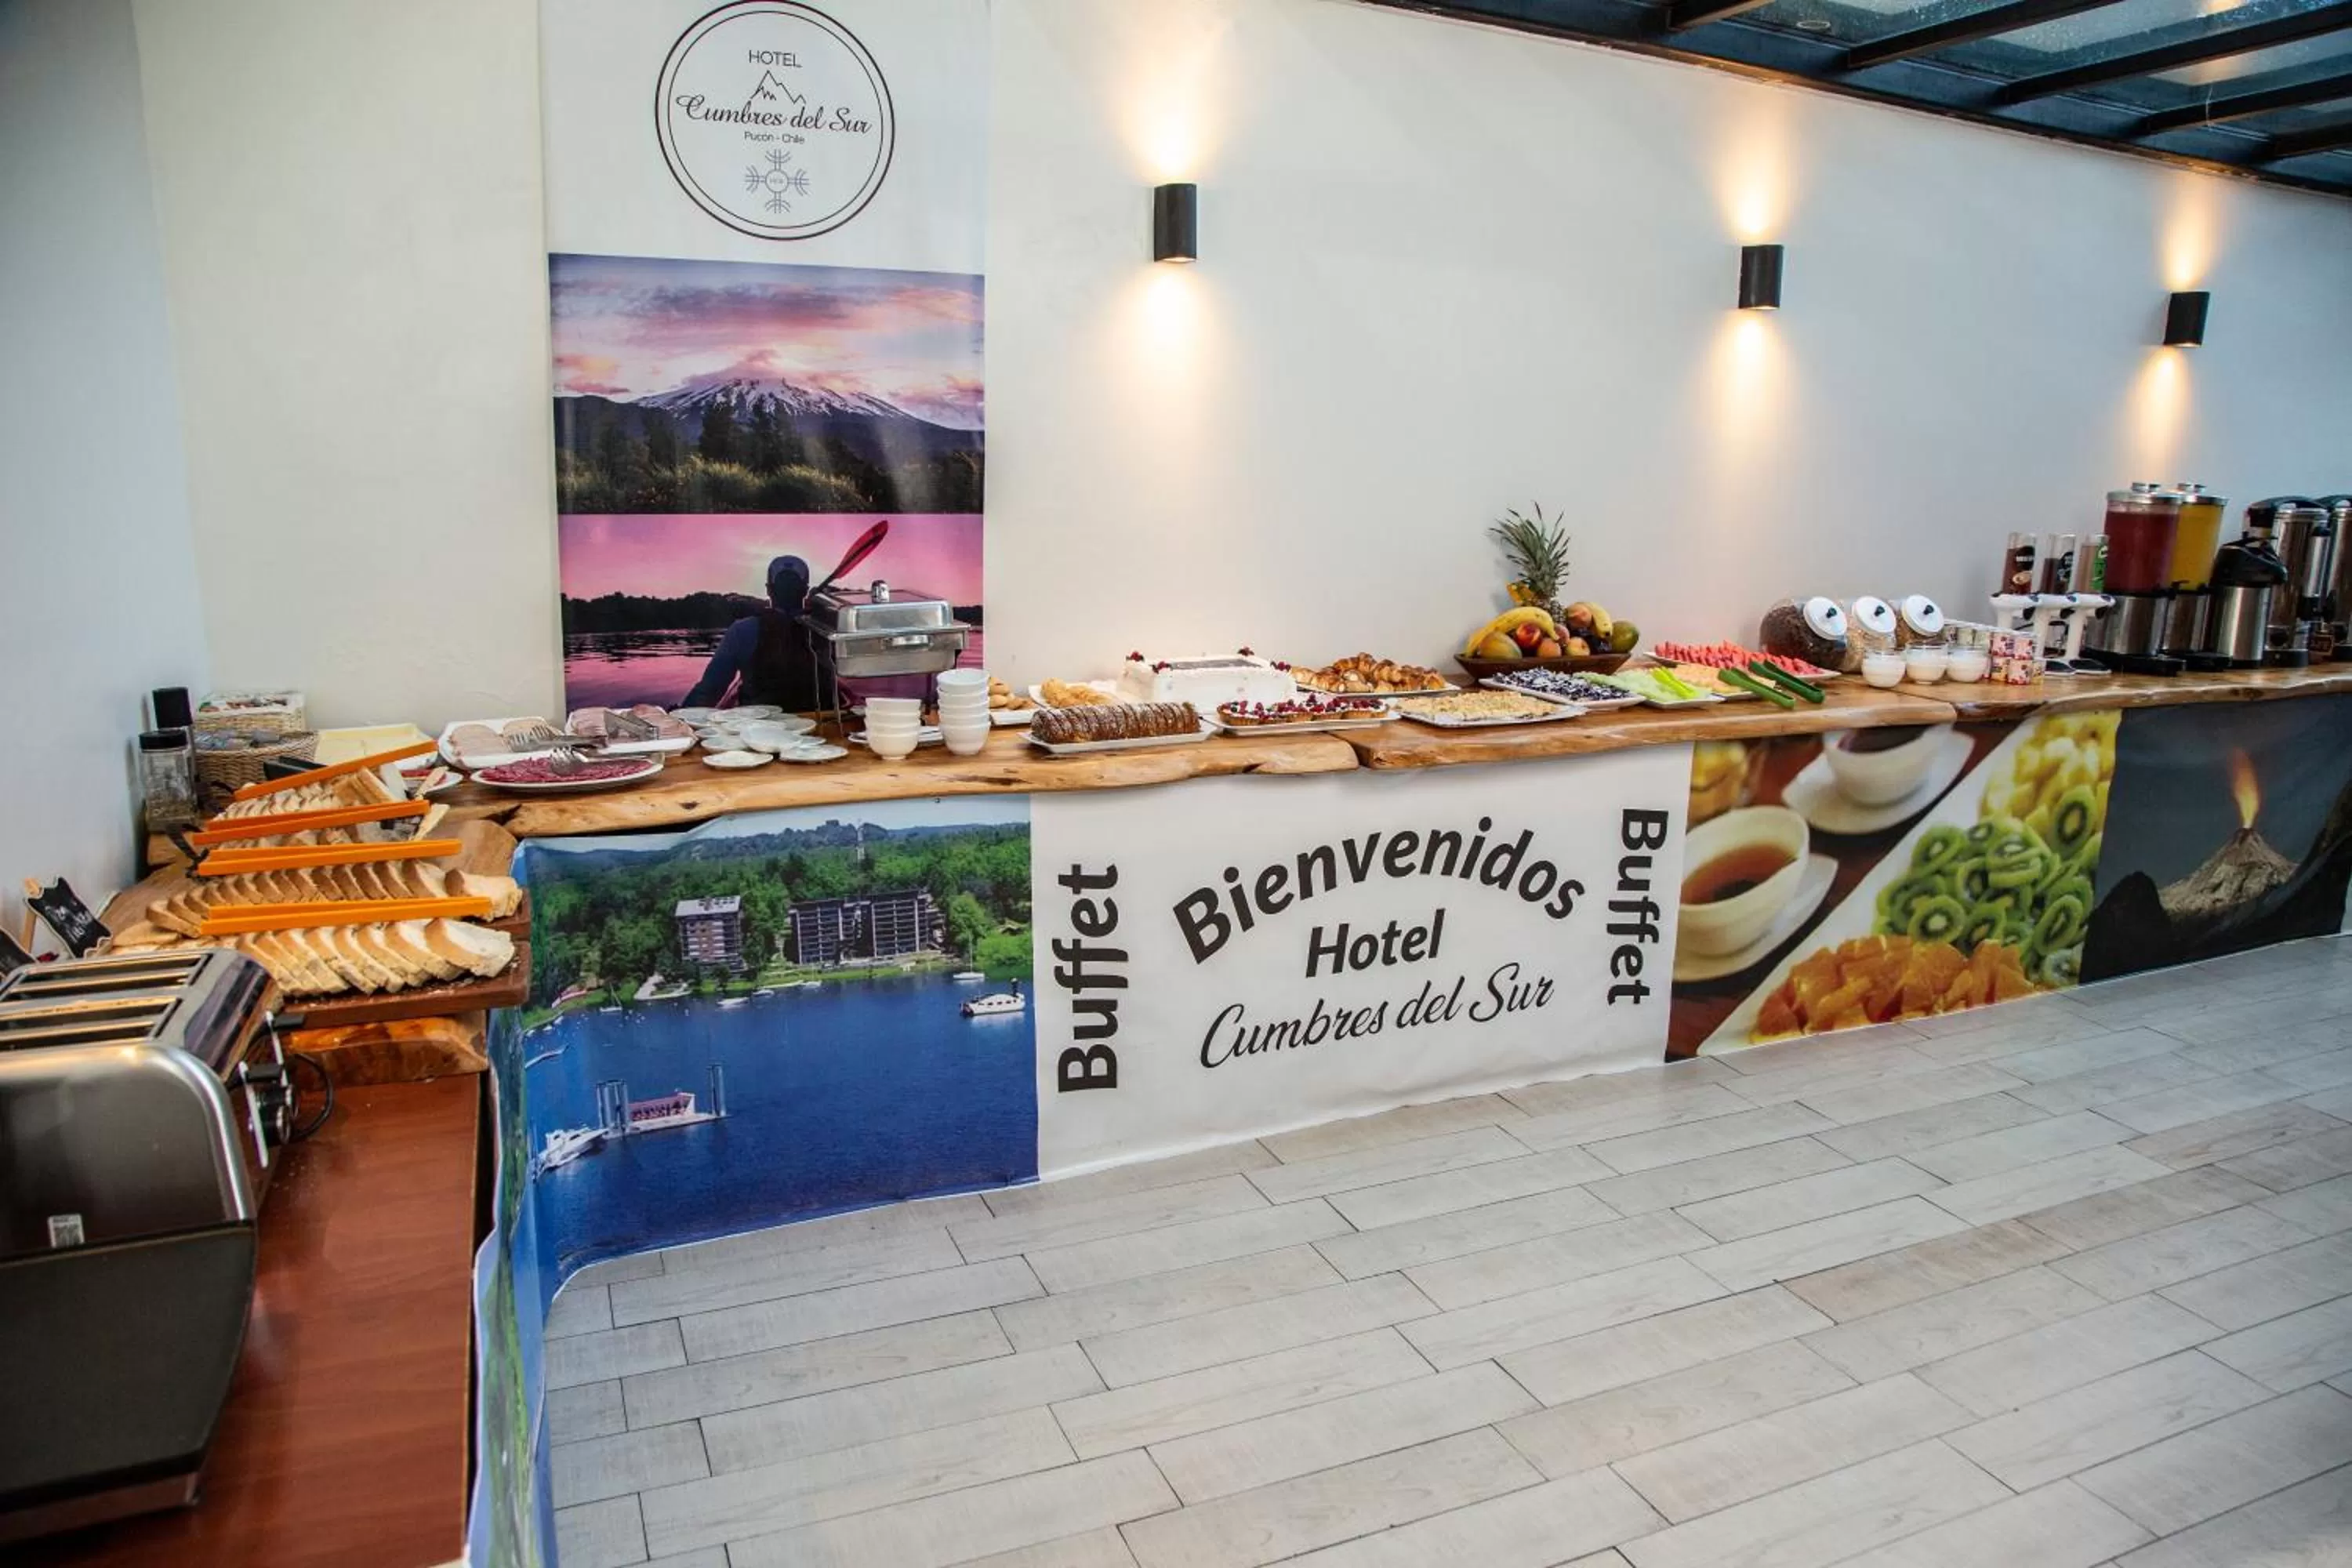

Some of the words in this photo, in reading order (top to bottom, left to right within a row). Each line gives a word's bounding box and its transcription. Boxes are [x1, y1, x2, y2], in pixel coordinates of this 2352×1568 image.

[749, 50, 802, 67] HOTEL
[676, 94, 787, 125] Cumbres
[789, 106, 825, 129] del
[829, 107, 871, 133] Sur
[782, 133, 805, 144] Chile
[1173, 817, 1584, 964] Bienvenidos
[1607, 809, 1669, 1005] Buffet
[1052, 863, 1128, 1093] Buffet
[1306, 909, 1445, 978] Hotel
[1201, 1000, 1386, 1068] Cumbres
[1396, 976, 1465, 1029] del
[1469, 963, 1553, 1022] Sur
